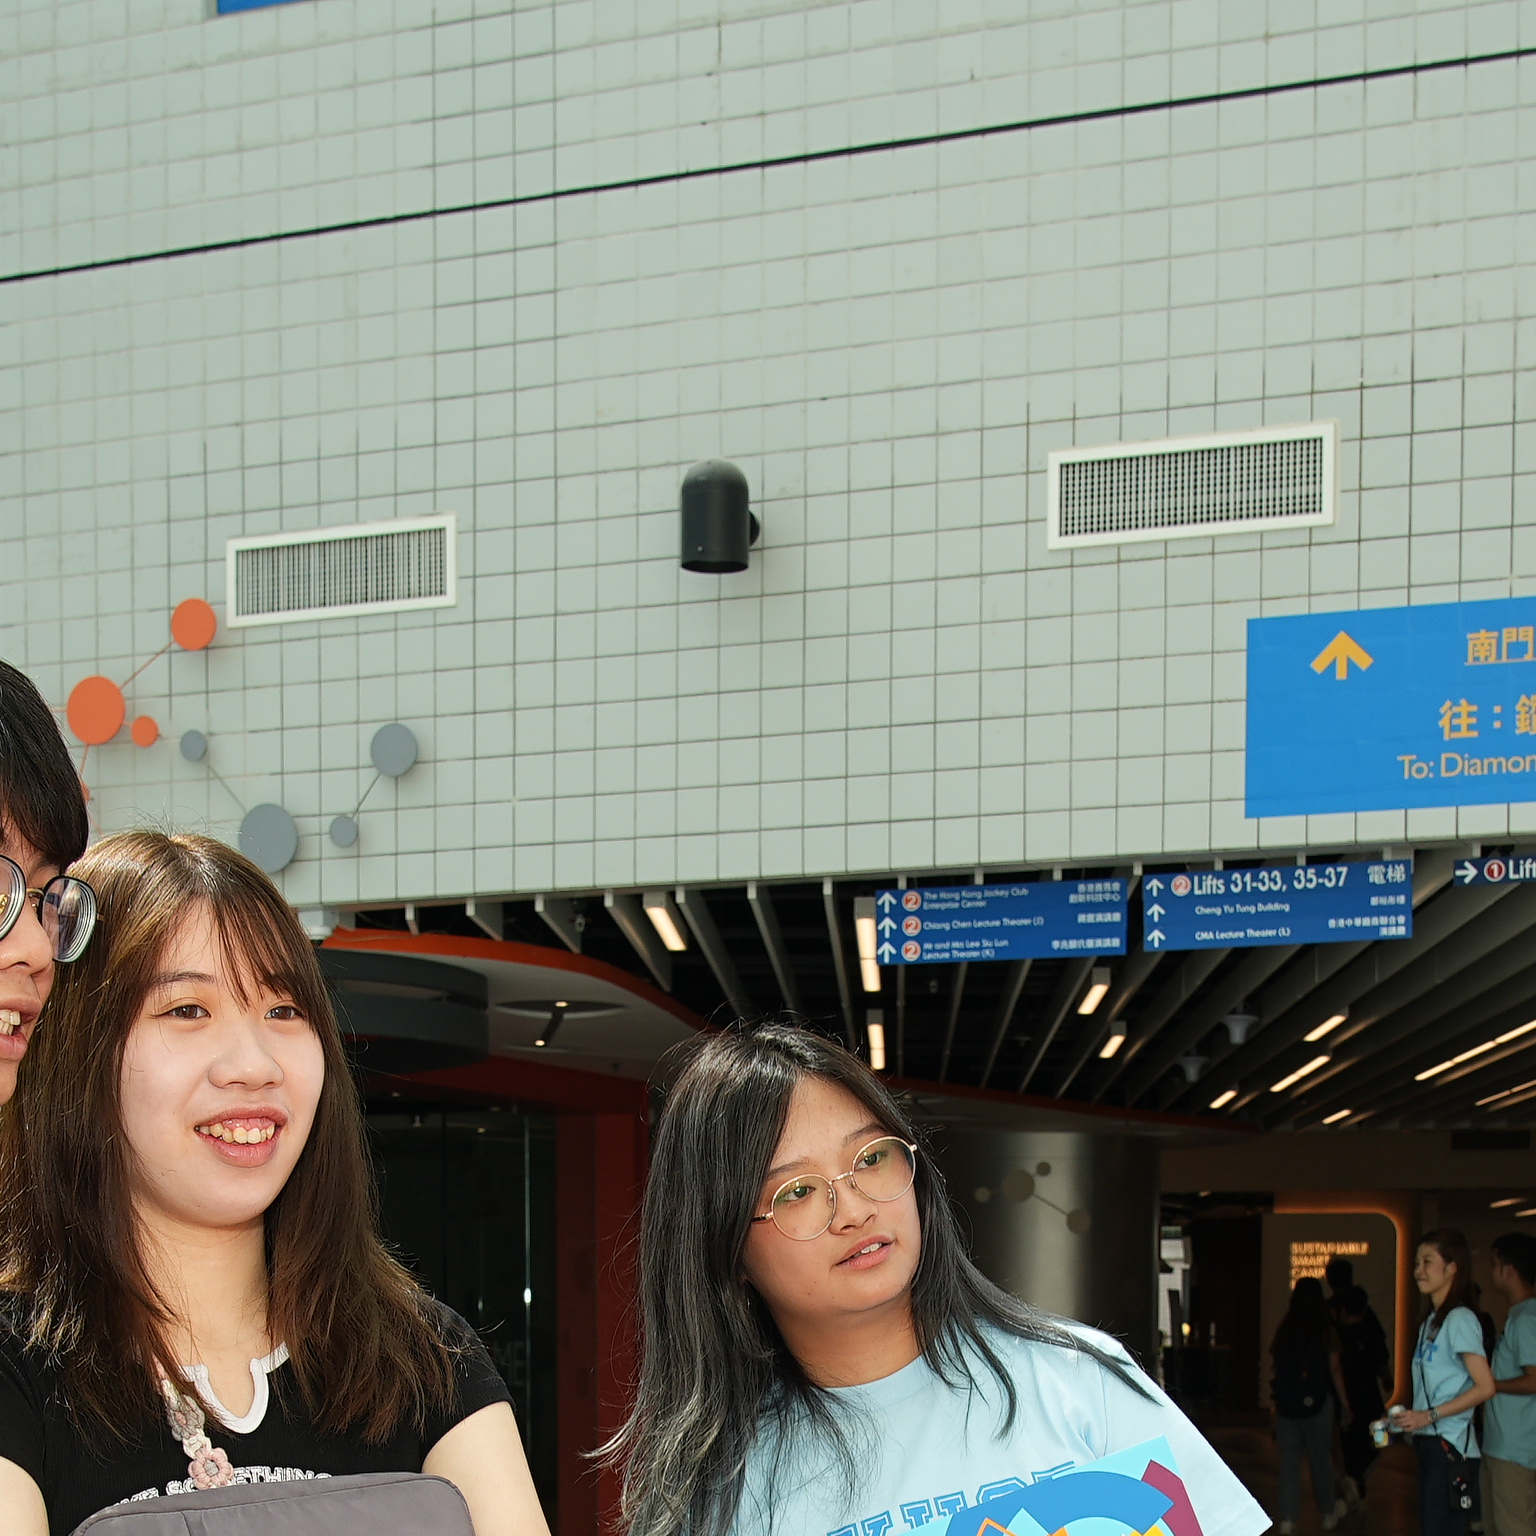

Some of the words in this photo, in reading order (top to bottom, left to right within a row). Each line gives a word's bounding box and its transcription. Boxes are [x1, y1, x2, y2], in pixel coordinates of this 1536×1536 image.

[1397, 754, 1434, 781] To:
[1193, 874, 1226, 896] Lifts
[1230, 869, 1288, 893] 31-33,
[1293, 866, 1349, 889] 35-37
[1367, 863, 1406, 886] 電梯
[1010, 887, 1029, 896] Club
[1195, 905, 1222, 916] Cheng
[1223, 904, 1234, 914] Yu
[1236, 904, 1256, 915] Tung
[1257, 902, 1291, 913] Building
[972, 919, 1002, 928] Lecture
[1195, 931, 1214, 941] CMA
[1216, 929, 1245, 940] Lecture
[1246, 928, 1277, 939] Theater
